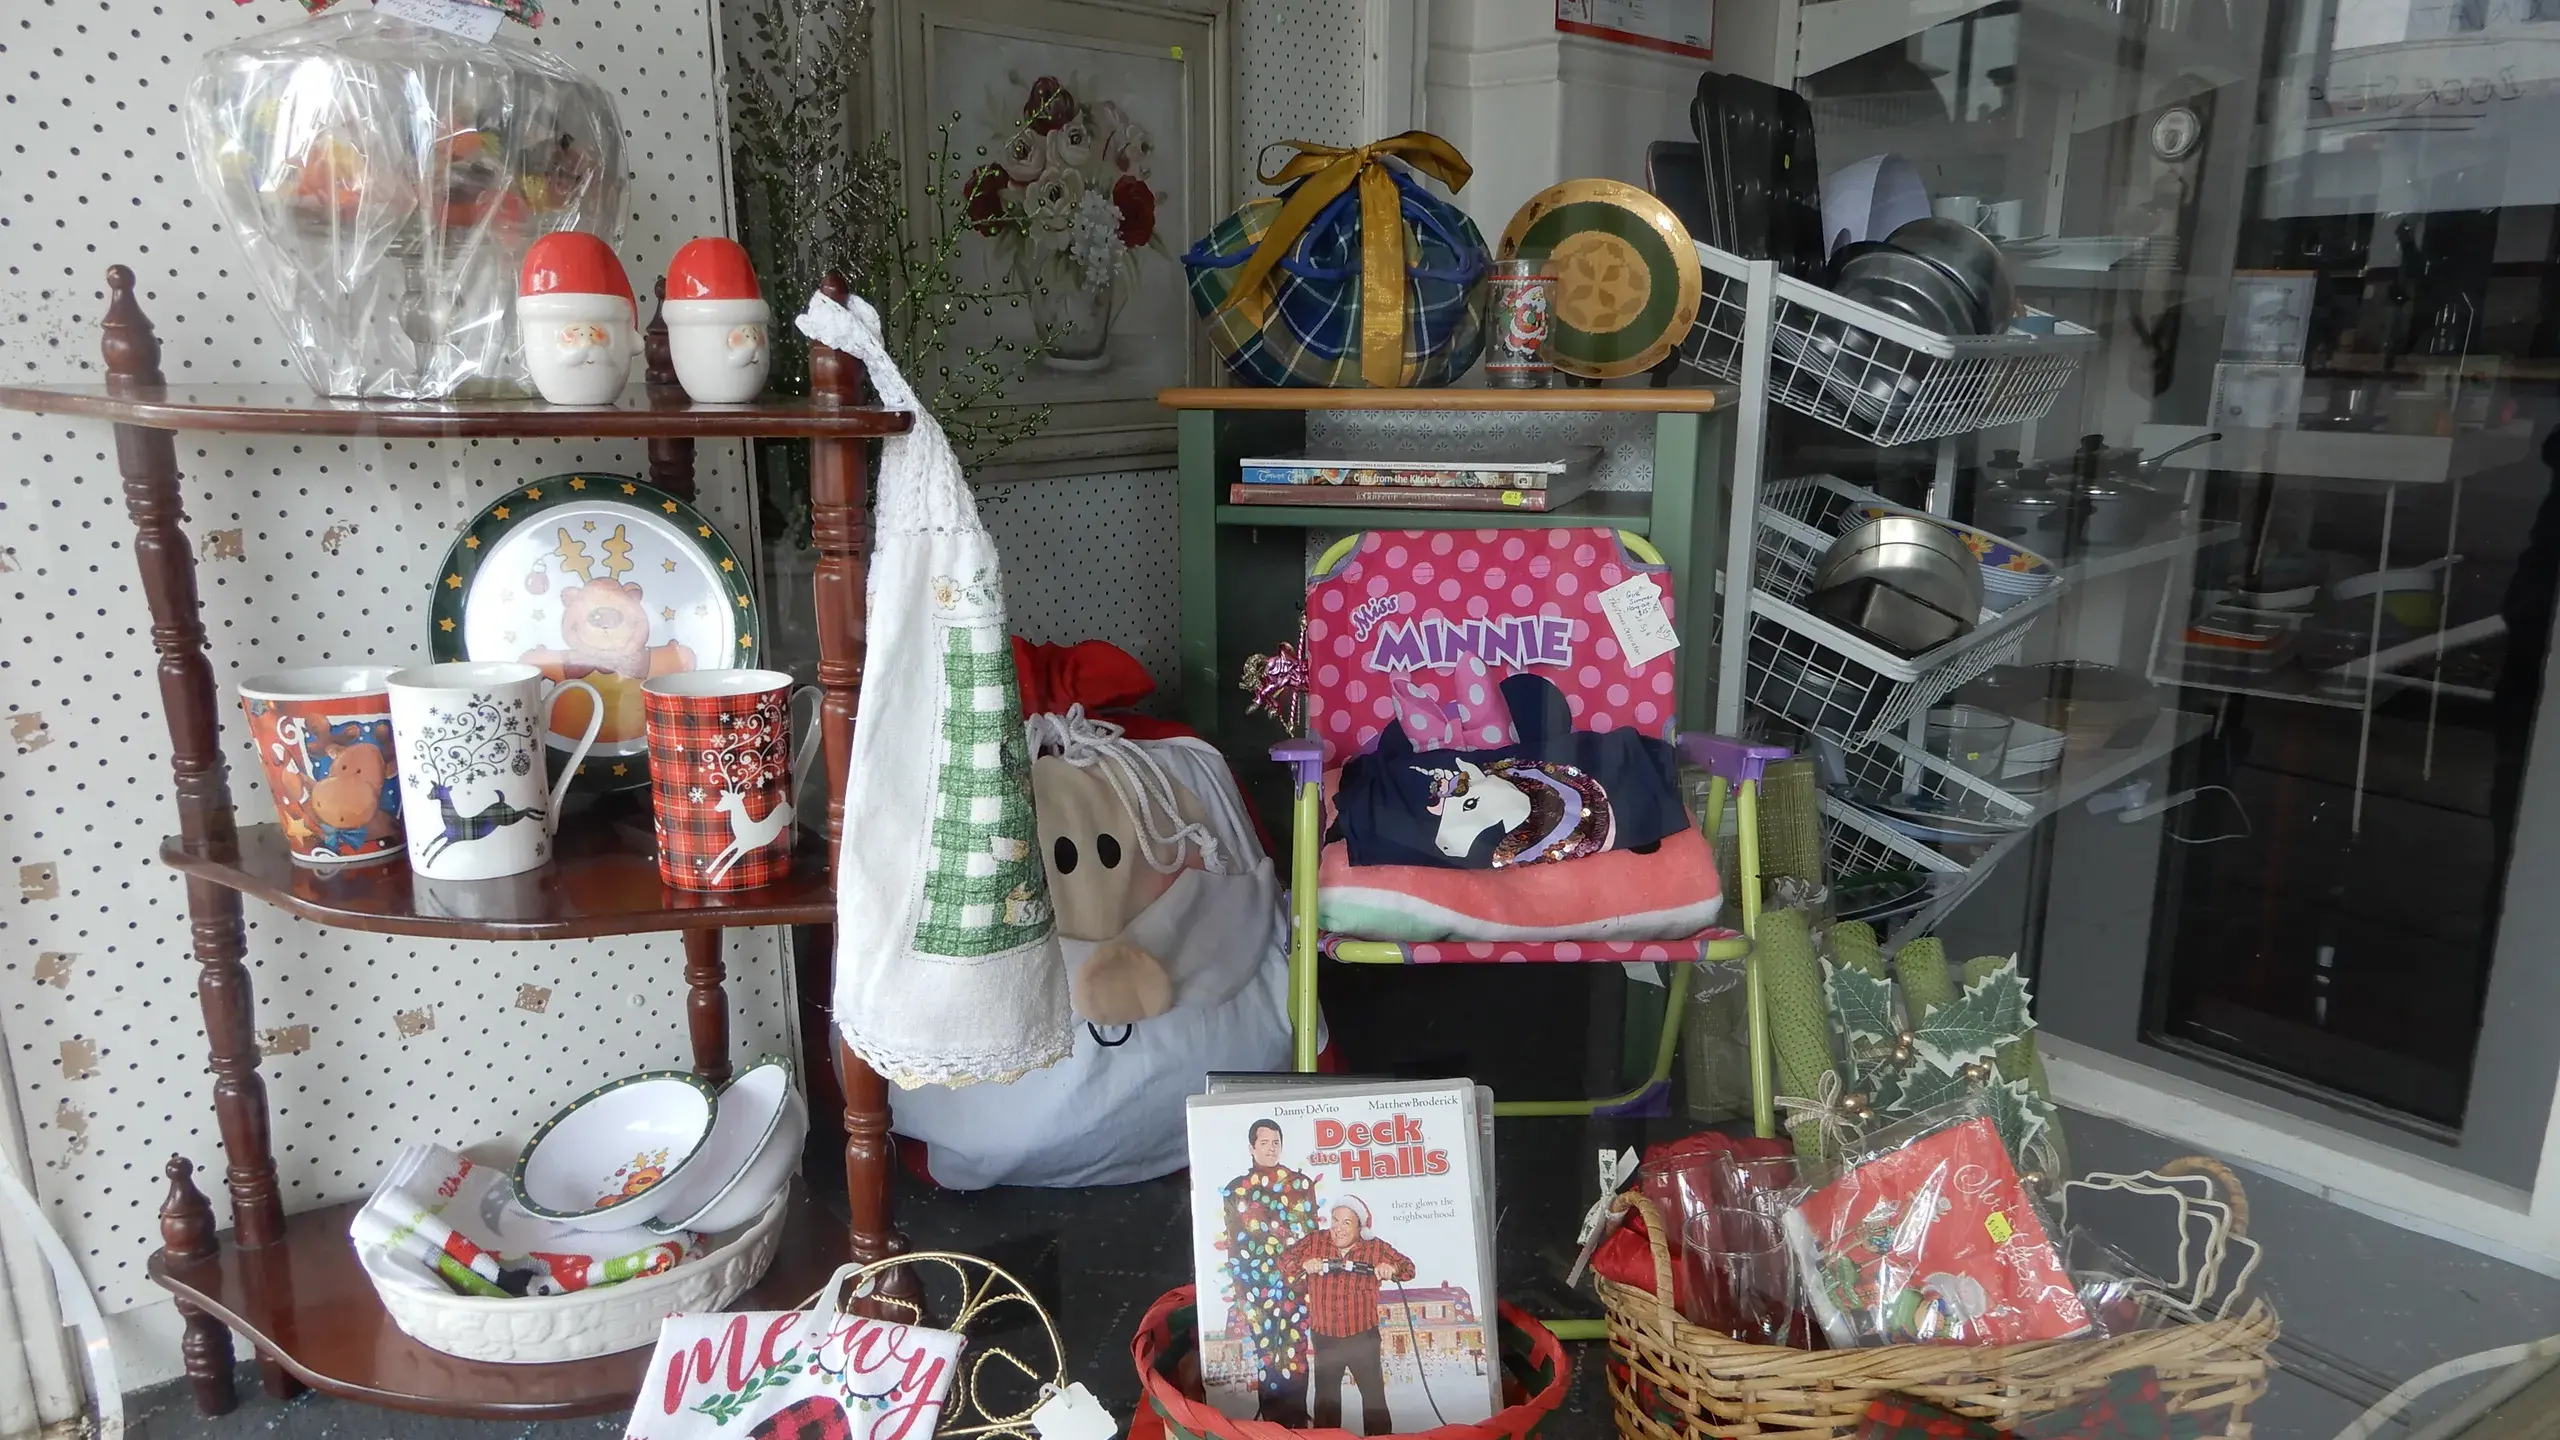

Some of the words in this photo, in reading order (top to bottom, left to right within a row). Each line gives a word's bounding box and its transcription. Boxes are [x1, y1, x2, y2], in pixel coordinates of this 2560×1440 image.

[1353, 472, 1372, 483] Gifts
[1373, 473, 1392, 484] from
[1394, 474, 1407, 483] the
[1410, 474, 1440, 484] Kitchen
[1350, 594, 1398, 642] Miss
[1370, 615, 1574, 672] MINNIE
[1368, 1098, 1412, 1110] Matthew
[1412, 1095, 1458, 1108] Broderick
[1274, 1106, 1305, 1118] Danny
[1306, 1104, 1339, 1115] DeVito
[1313, 1113, 1423, 1150] Deck
[1307, 1150, 1339, 1165] the
[1339, 1144, 1450, 1181] Halls
[1391, 1200, 1414, 1209] there
[1415, 1199, 1438, 1211] glows
[1440, 1198, 1454, 1207] the
[1392, 1209, 1455, 1222] neighbourhood
